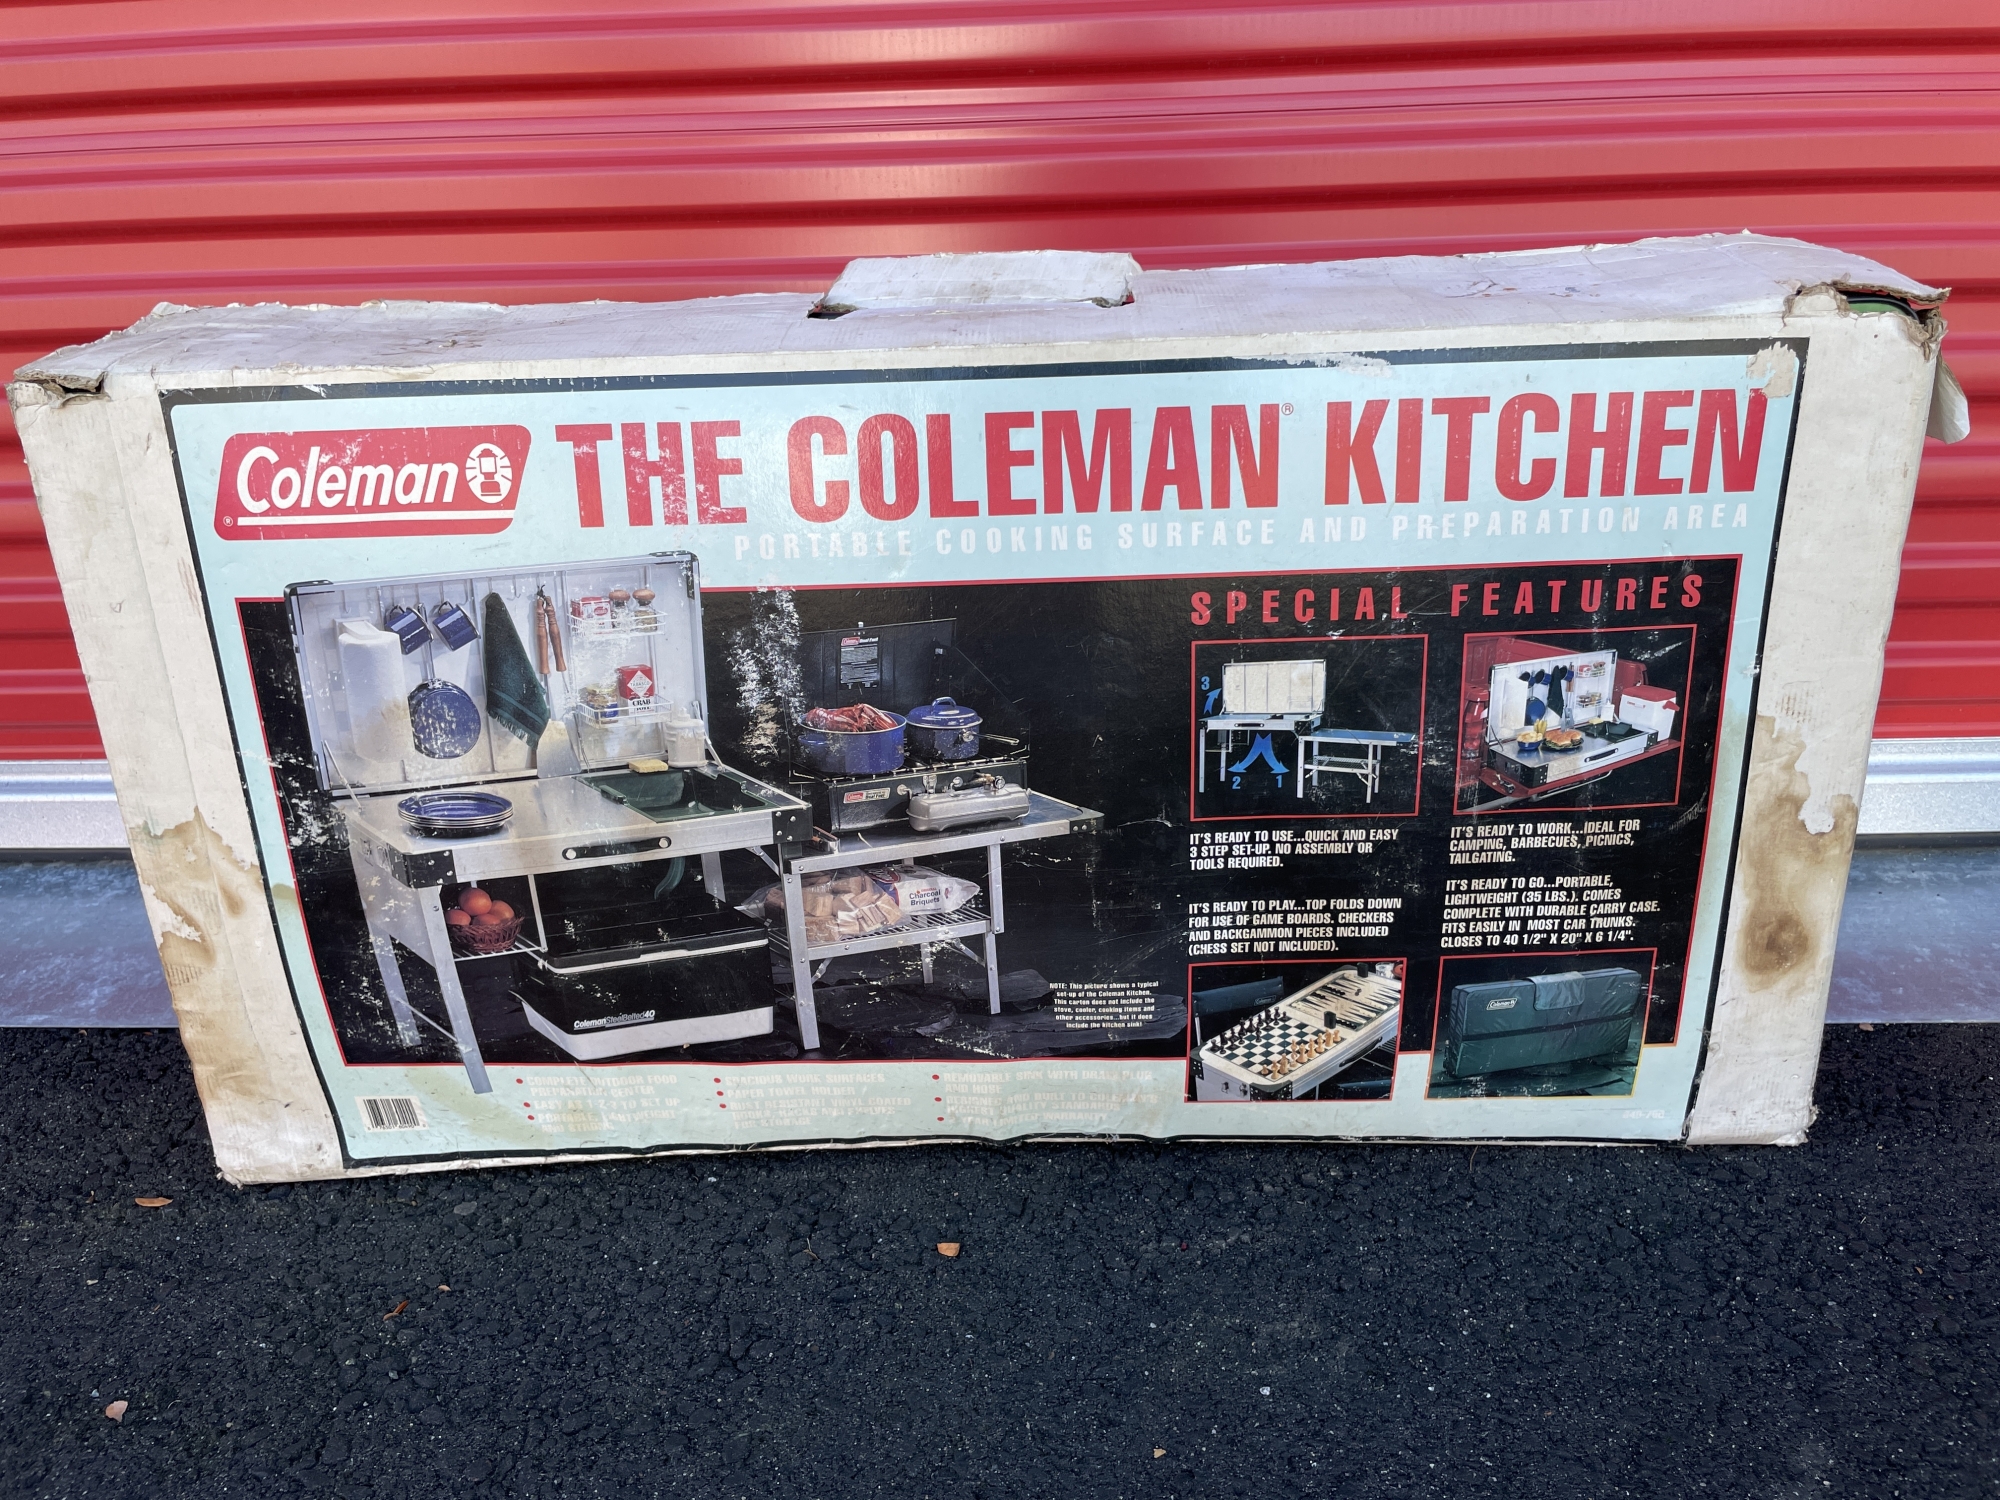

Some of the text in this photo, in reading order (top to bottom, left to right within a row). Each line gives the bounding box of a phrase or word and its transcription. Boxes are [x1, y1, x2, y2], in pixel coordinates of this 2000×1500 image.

[555, 420, 748, 528] THE
[1324, 388, 1768, 505] KITCHEN
[237, 444, 459, 513] Coleman
[735, 502, 1747, 560] PORTABLE COOKING SURFACE AND AREA
[1190, 575, 1703, 627] SPECIAL FEATURES
[1201, 676, 1210, 690] 3
[1232, 776, 1241, 789] 2
[1276, 776, 1282, 787] 1
[1451, 826, 1473, 838] IT'S
[1477, 825, 1514, 837] READY
[1518, 824, 1533, 835] TO
[1619, 819, 1640, 831] FOR
[1190, 833, 1211, 845] IT'S
[1215, 832, 1250, 844] READY
[1255, 831, 1269, 841] TO
[1343, 830, 1366, 840] AND
[1370, 829, 1399, 840] EASY
[1450, 834, 1634, 852] CAMPING, BARBECUES, PICNICS,
[1190, 842, 1373, 857] 3 STEP SET-UP. NO ASSEMBLY OR
[1449, 851, 1515, 864] TAILGATING.
[1190, 856, 1283, 870] TOOLS REQUIRED.
[1446, 880, 1467, 891] IT'S
[1471, 878, 1507, 890] READY
[1512, 878, 1526, 888] TO
[909, 889, 941, 899] Charcoal
[910, 897, 940, 906] Briquets
[1445, 892, 1518, 905] LIGHTWEIGHT
[1521, 891, 1541, 904] (35
[1583, 889, 1621, 901] COMES
[1189, 903, 1209, 914] IT'S
[1213, 901, 1247, 913] READY
[1252, 900, 1265, 911] TO
[1330, 899, 1364, 910] FOLDS
[1368, 898, 1402, 909] DOWN
[1444, 901, 1661, 919] COMPLETE WITH DURABLE CARRY CASE.
[1189, 912, 1394, 928] FOR USE OF GAME BOARDS. CHECKERS
[1442, 916, 1636, 933] FITS EASILY IN MOST CAR TRUNKS.
[1189, 926, 1388, 942] AND BACKGAMMON PIECES INCLUDED
[1441, 935, 1482, 948] CLOSES
[1486, 935, 1500, 946] TO
[1503, 934, 1518, 945] 40
[1550, 933, 1557, 944] X
[1585, 932, 1592, 943] X
[1596, 931, 1602, 942] 6
[1189, 940, 1339, 956] (CHESS SET NOT INCLUDED).
[1137, 981, 1159, 989] typical
[648, 1075, 677, 1084] FOOD
[826, 1074, 885, 1083] SURFACES
